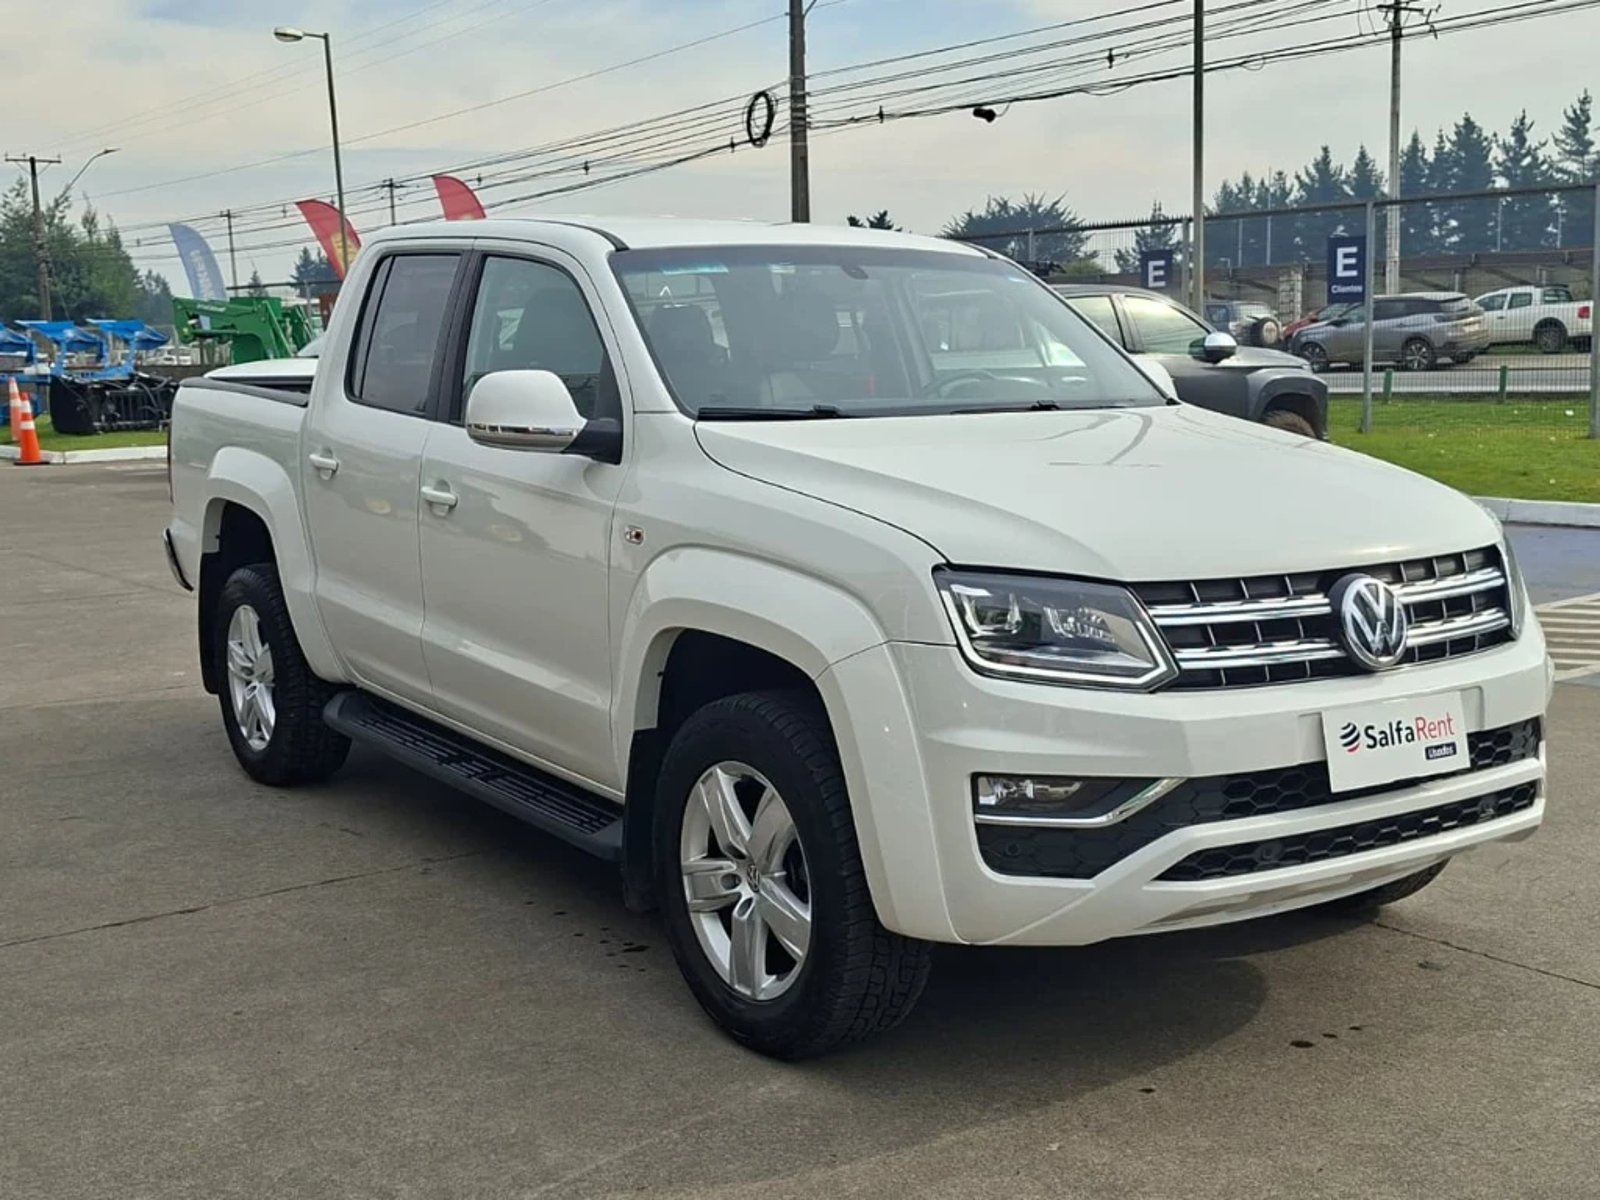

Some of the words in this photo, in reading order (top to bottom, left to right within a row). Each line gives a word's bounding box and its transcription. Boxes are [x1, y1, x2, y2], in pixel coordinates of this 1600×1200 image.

[1148, 260, 1166, 288] E
[1337, 247, 1358, 277] E
[1343, 579, 1404, 666] VW
[1363, 712, 1456, 749] SalfaRent
